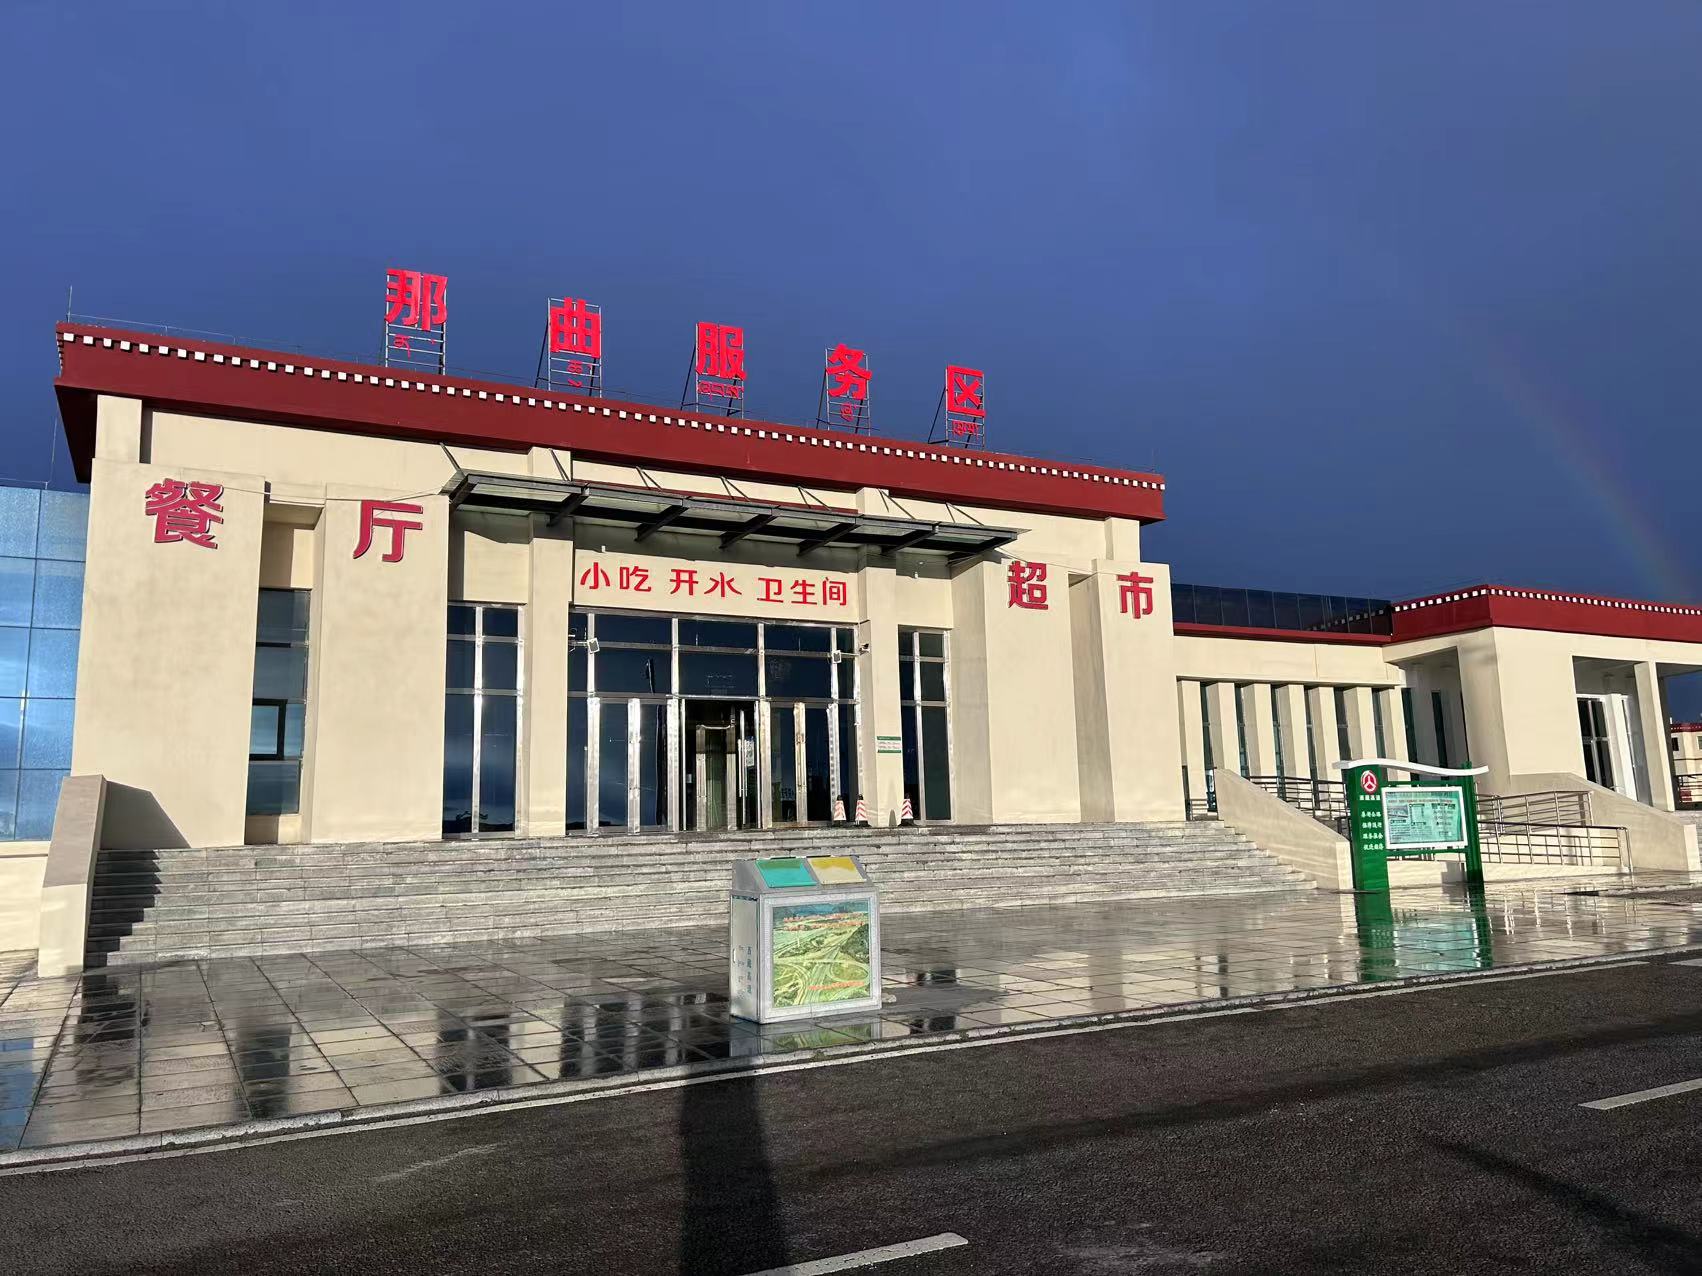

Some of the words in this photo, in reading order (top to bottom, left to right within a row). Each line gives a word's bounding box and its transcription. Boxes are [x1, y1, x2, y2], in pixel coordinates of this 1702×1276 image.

[384, 268, 986, 417] 那曲服务区
[145, 479, 423, 562] 餐厅
[580, 562, 652, 592] 小吃
[670, 568, 742, 598] 开水
[757, 577, 847, 606] 卫生间
[1007, 560, 1154, 619] 超市
